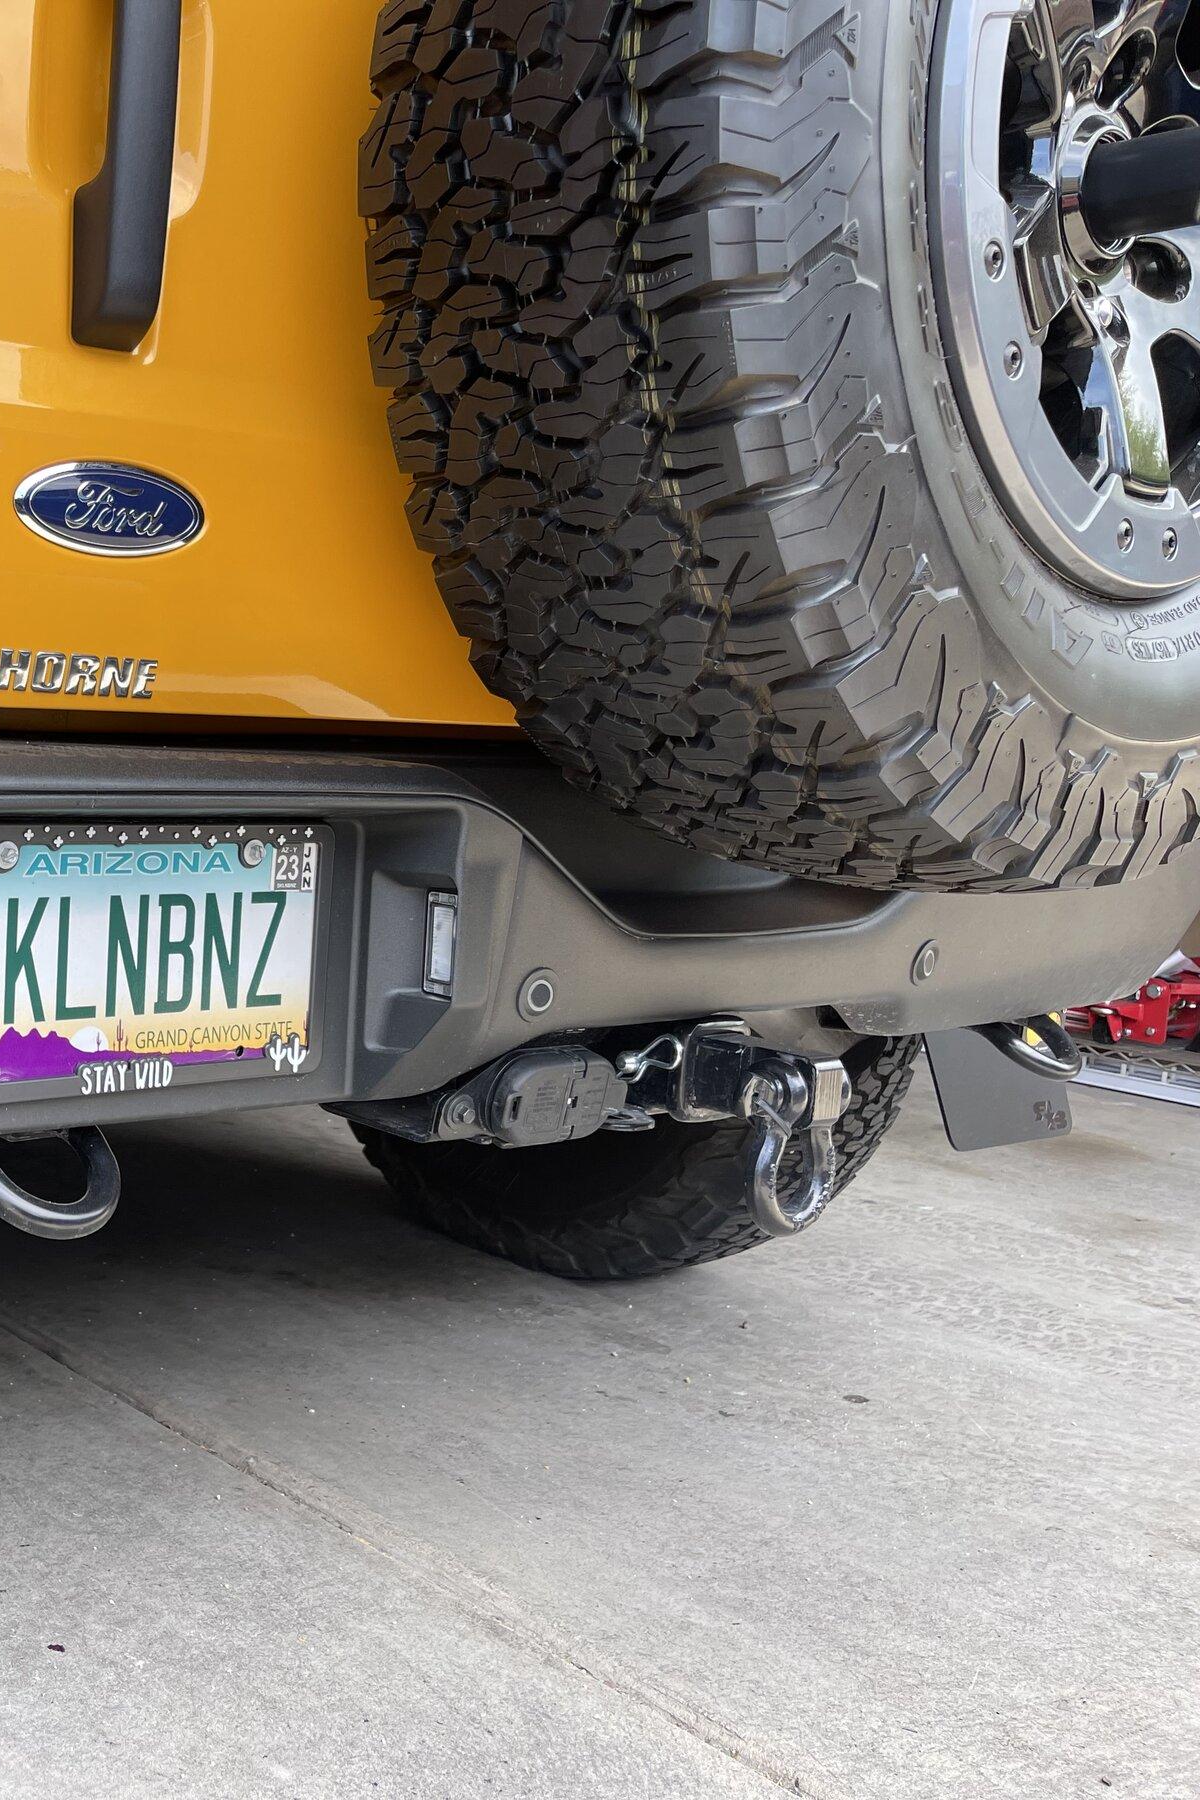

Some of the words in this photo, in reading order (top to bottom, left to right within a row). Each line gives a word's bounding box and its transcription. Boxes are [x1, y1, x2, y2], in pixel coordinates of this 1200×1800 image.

[64, 480, 169, 537] Ford
[22, 850, 233, 878] ARIZONA
[275, 854, 299, 881] 23
[302, 846, 312, 888] JAN
[135, 1028, 188, 1050] GRAND
[191, 1023, 251, 1046] CANYON
[255, 1020, 293, 1040] STATE
[81, 1063, 128, 1095] STAY
[135, 1060, 173, 1090] WILD
